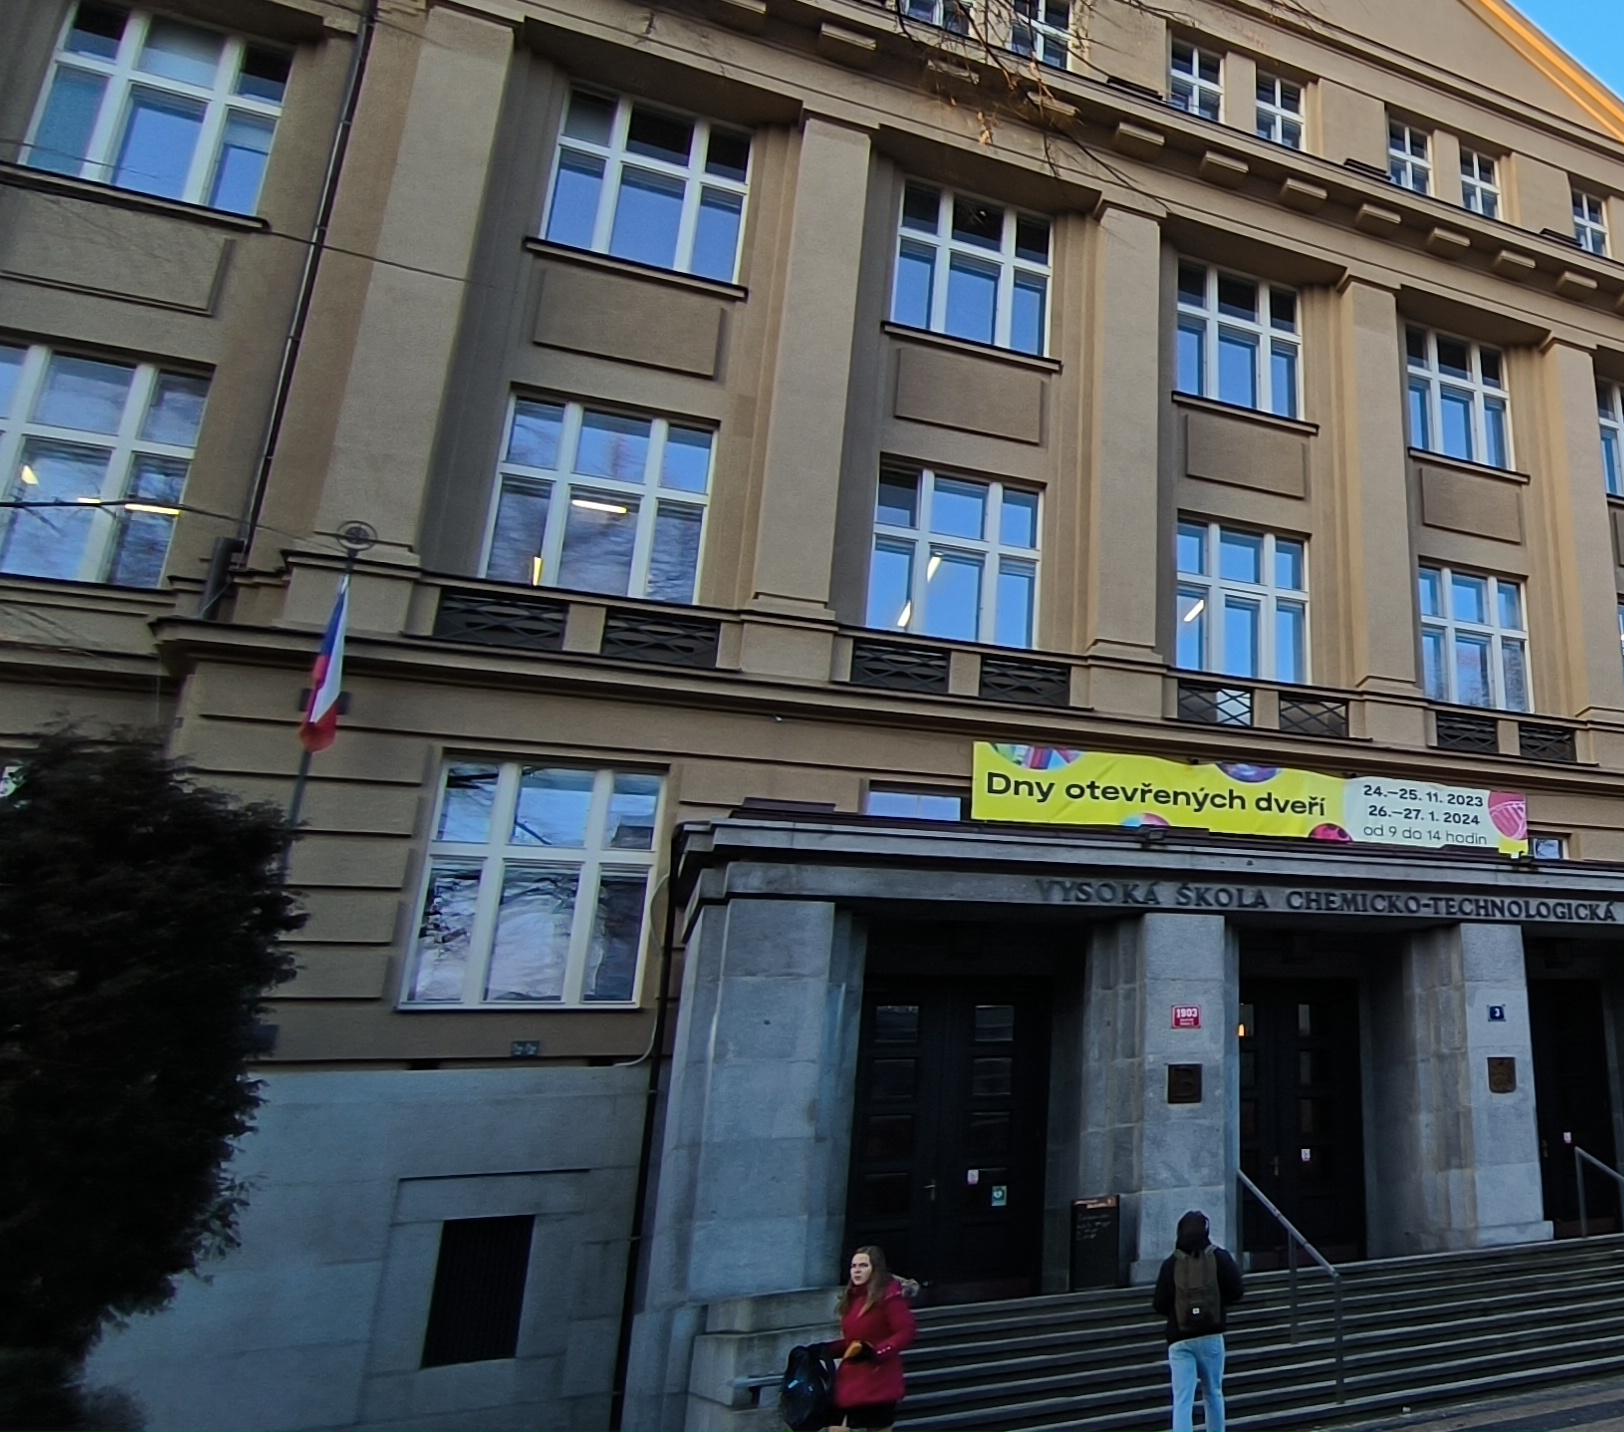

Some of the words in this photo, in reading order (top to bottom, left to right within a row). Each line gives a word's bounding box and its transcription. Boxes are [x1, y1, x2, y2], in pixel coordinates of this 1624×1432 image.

[987, 771, 1056, 803] Dny
[1065, 781, 1246, 812] otevřených
[1255, 792, 1326, 816] dveří
[1426, 791, 1443, 803] 11.
[1447, 793, 1484, 807] 2023
[1428, 811, 1439, 821] 1.
[1443, 812, 1481, 825] 2024
[1363, 824, 1384, 837] od
[1388, 825, 1397, 837] 9
[1402, 827, 1422, 840] do
[1427, 830, 1442, 841] 14
[1446, 831, 1488, 845] hodin
[1035, 879, 1161, 905] VYSOKÁ
[1175, 881, 1269, 909] ŠKOLA
[1286, 889, 1617, 922] CHEMICKO-TECHNOLOGICKÁ
[1176, 1007, 1198, 1018] 1903
